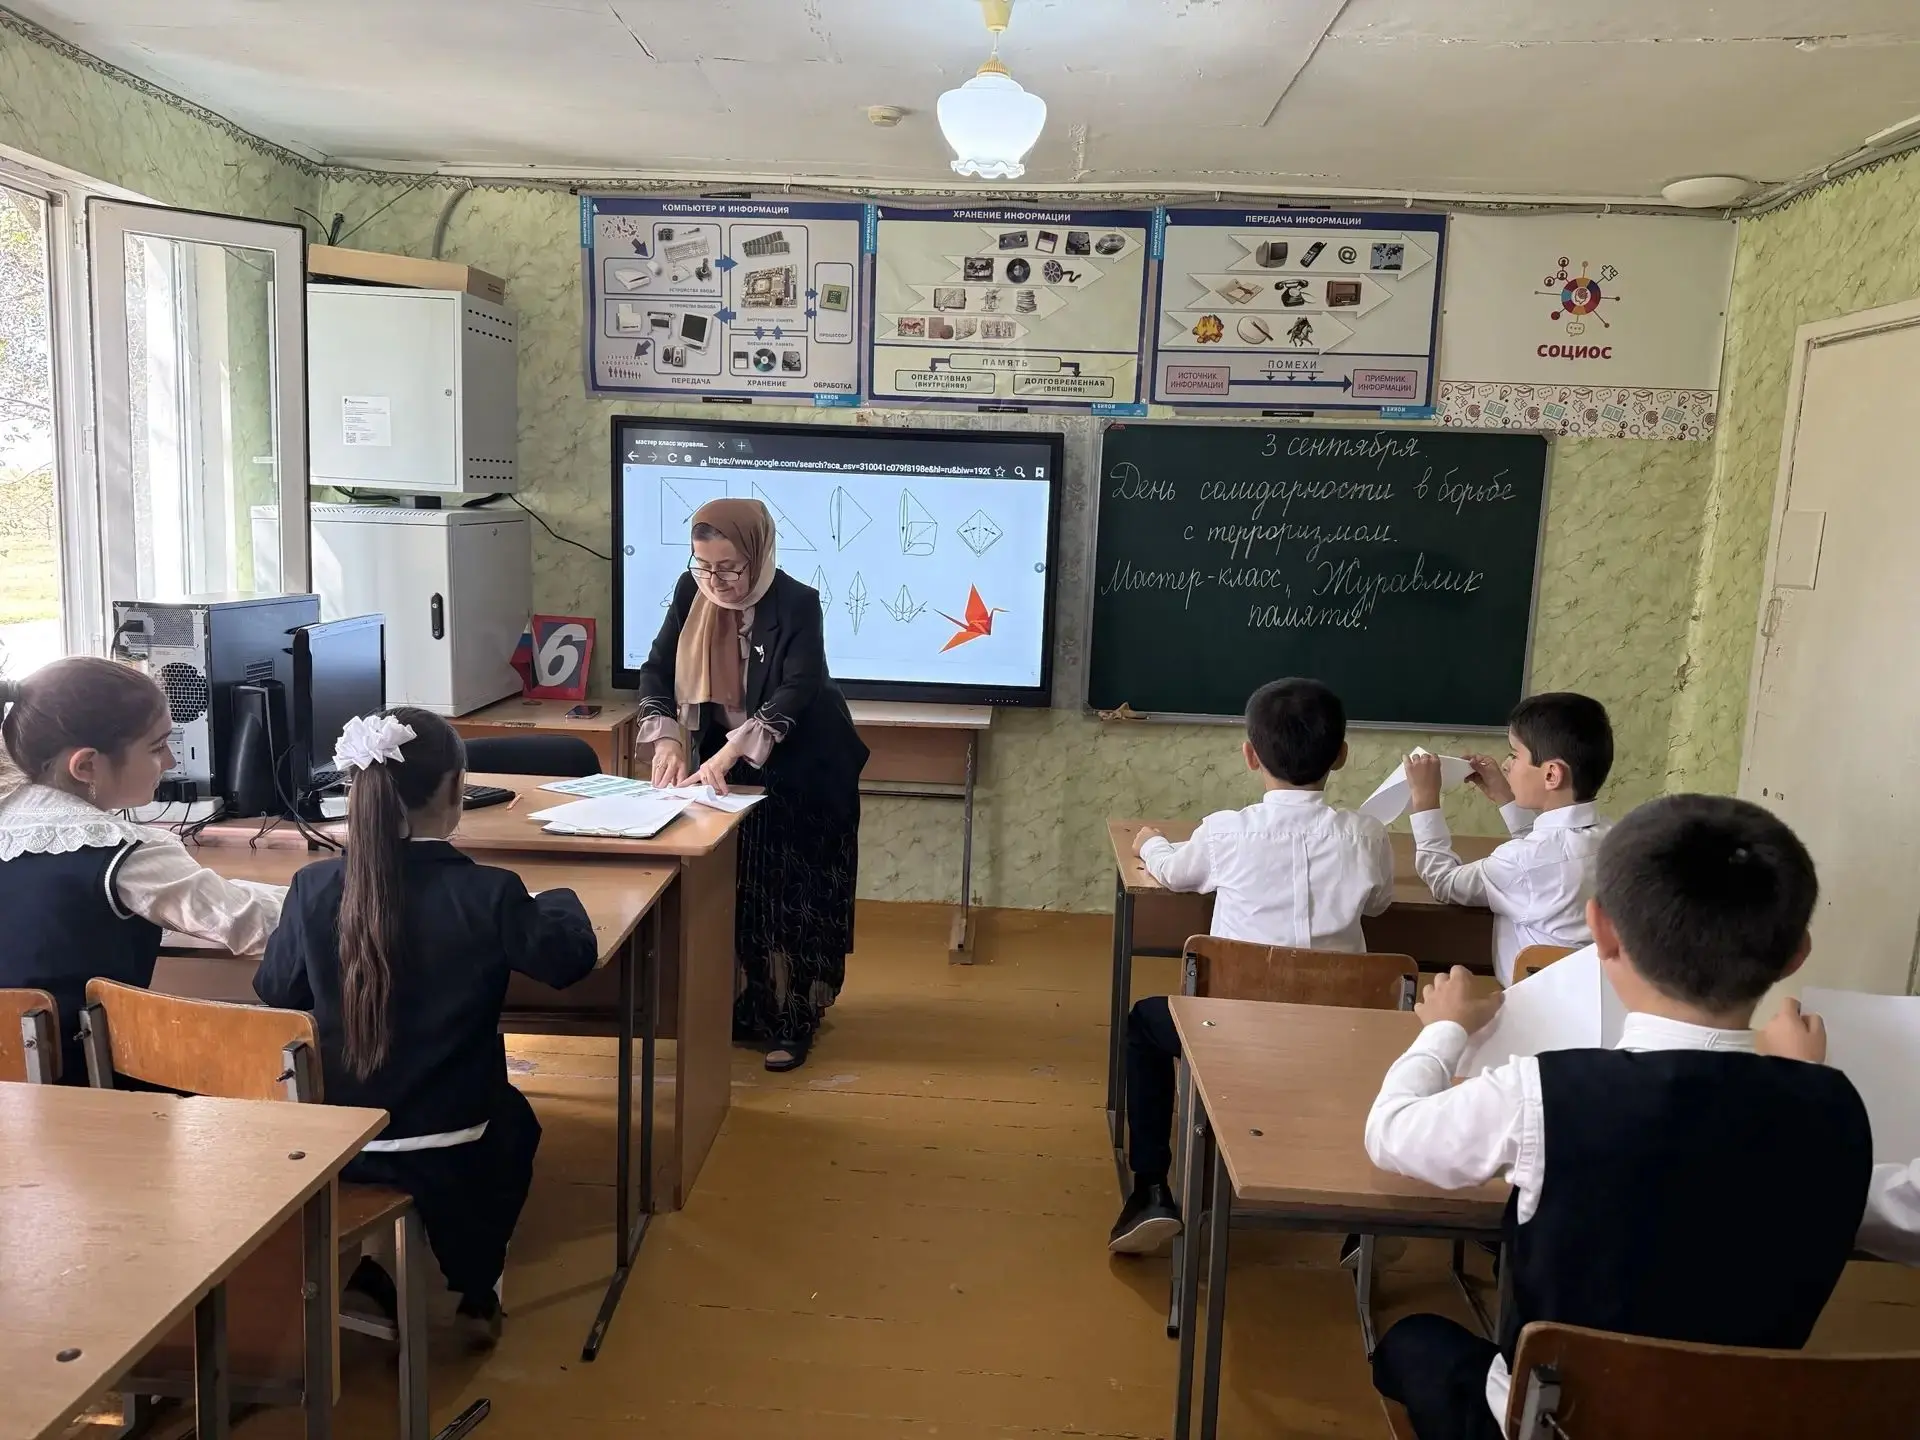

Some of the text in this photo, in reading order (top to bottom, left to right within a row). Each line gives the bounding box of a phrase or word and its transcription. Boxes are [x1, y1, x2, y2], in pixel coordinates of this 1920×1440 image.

[662, 203, 717, 213] КОМПЬЮТЕР
[728, 205, 790, 214] ИНФОРМАЦИЯ
[953, 210, 1071, 222] ХРАНЕНИЕ ИНФОРМАЦИИ
[1245, 215, 1362, 225] ПЕРЕДАЧА ИНФОРМАЦИИ
[1536, 344, 1613, 360] СОЦИОС
[982, 358, 1029, 368] ПАМЯТЬ
[1268, 360, 1318, 369] ПОМЕХИ
[911, 373, 972, 382] ОПЕРАТИВНАЯ
[1177, 371, 1218, 380] ИСТОЧНИК
[671, 377, 711, 385] ПЕРЕДАЧА
[747, 379, 788, 387] ХРАНЕНИЕ
[914, 381, 968, 390] (ВНУТРЕННЯЯ)
[1024, 377, 1105, 387] ДОЛГОВРЕМЕННАЯ
[1170, 380, 1224, 389] ИНФОРМАЦИИ
[1043, 385, 1085, 394] (ВНЕШНЯЯ)
[1357, 383, 1412, 393] ИНФОРМАЦИИ
[1261, 433, 1277, 457] 3
[1109, 461, 1517, 521] День солидарности в борьбе
[1183, 522, 1399, 562] с терроризмом.
[539, 623, 588, 687] 6
